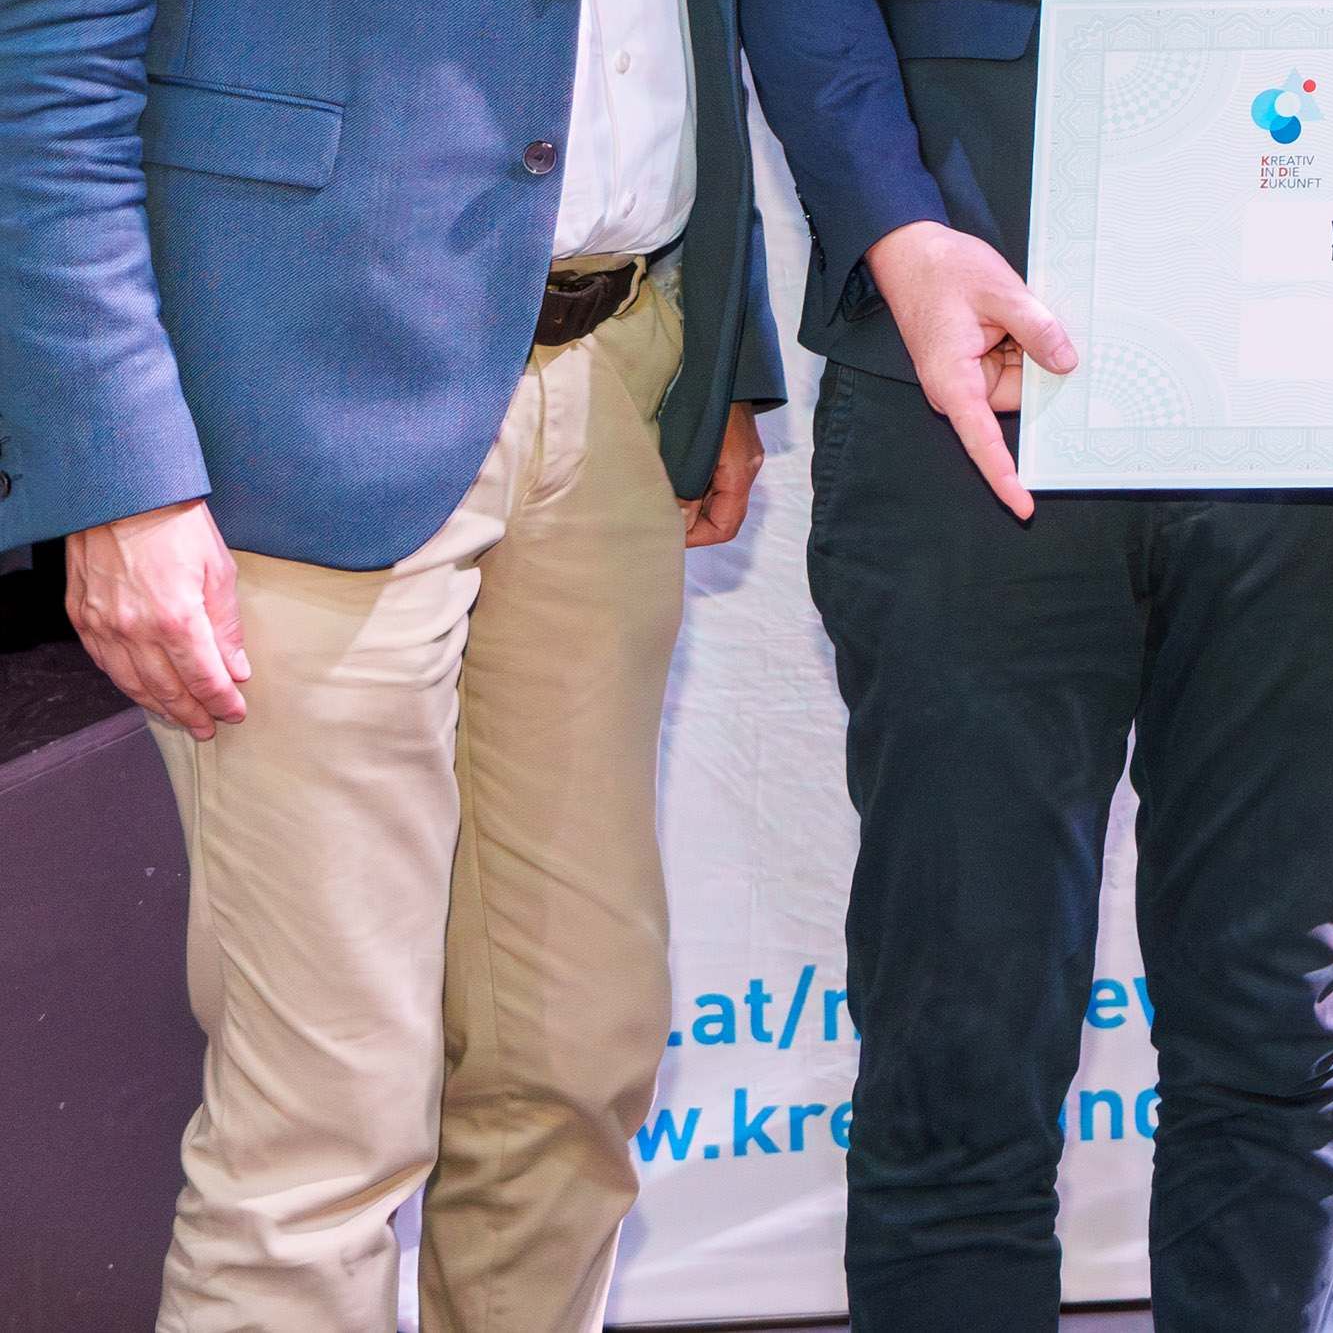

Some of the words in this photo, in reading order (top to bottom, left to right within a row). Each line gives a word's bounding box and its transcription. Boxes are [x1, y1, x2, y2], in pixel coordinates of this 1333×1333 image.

[1261, 155, 1315, 166] KREATIV
[1260, 167, 1275, 177] IN
[1278, 167, 1300, 177] DIE
[1260, 178, 1322, 189] ZUKUNFT
